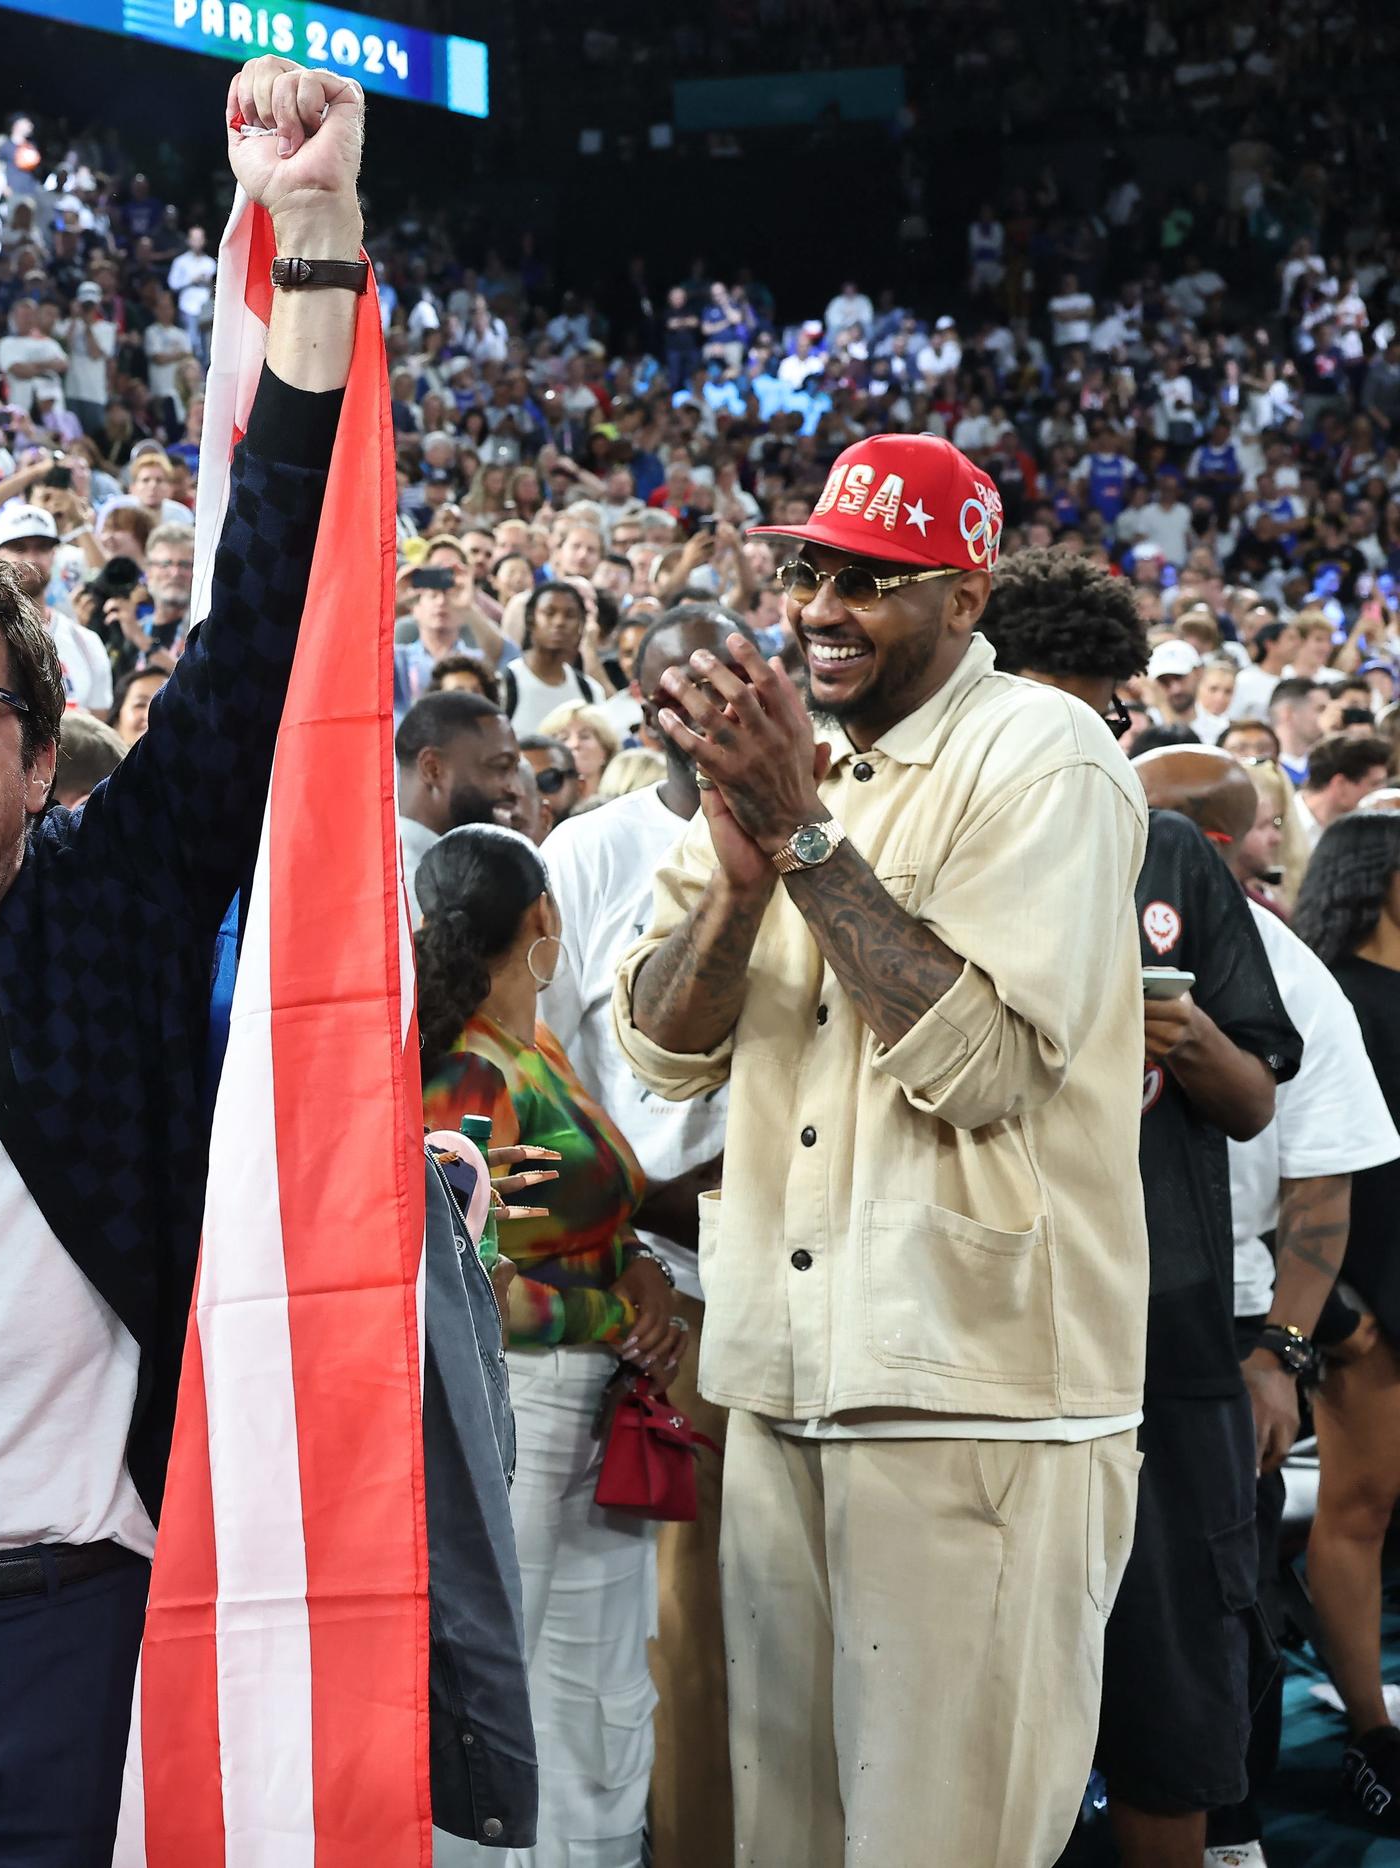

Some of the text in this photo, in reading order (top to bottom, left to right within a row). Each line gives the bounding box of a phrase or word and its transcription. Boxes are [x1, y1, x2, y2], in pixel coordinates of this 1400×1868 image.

[174, 0, 409, 80] PARIS 2024
[814, 463, 905, 531] USA
